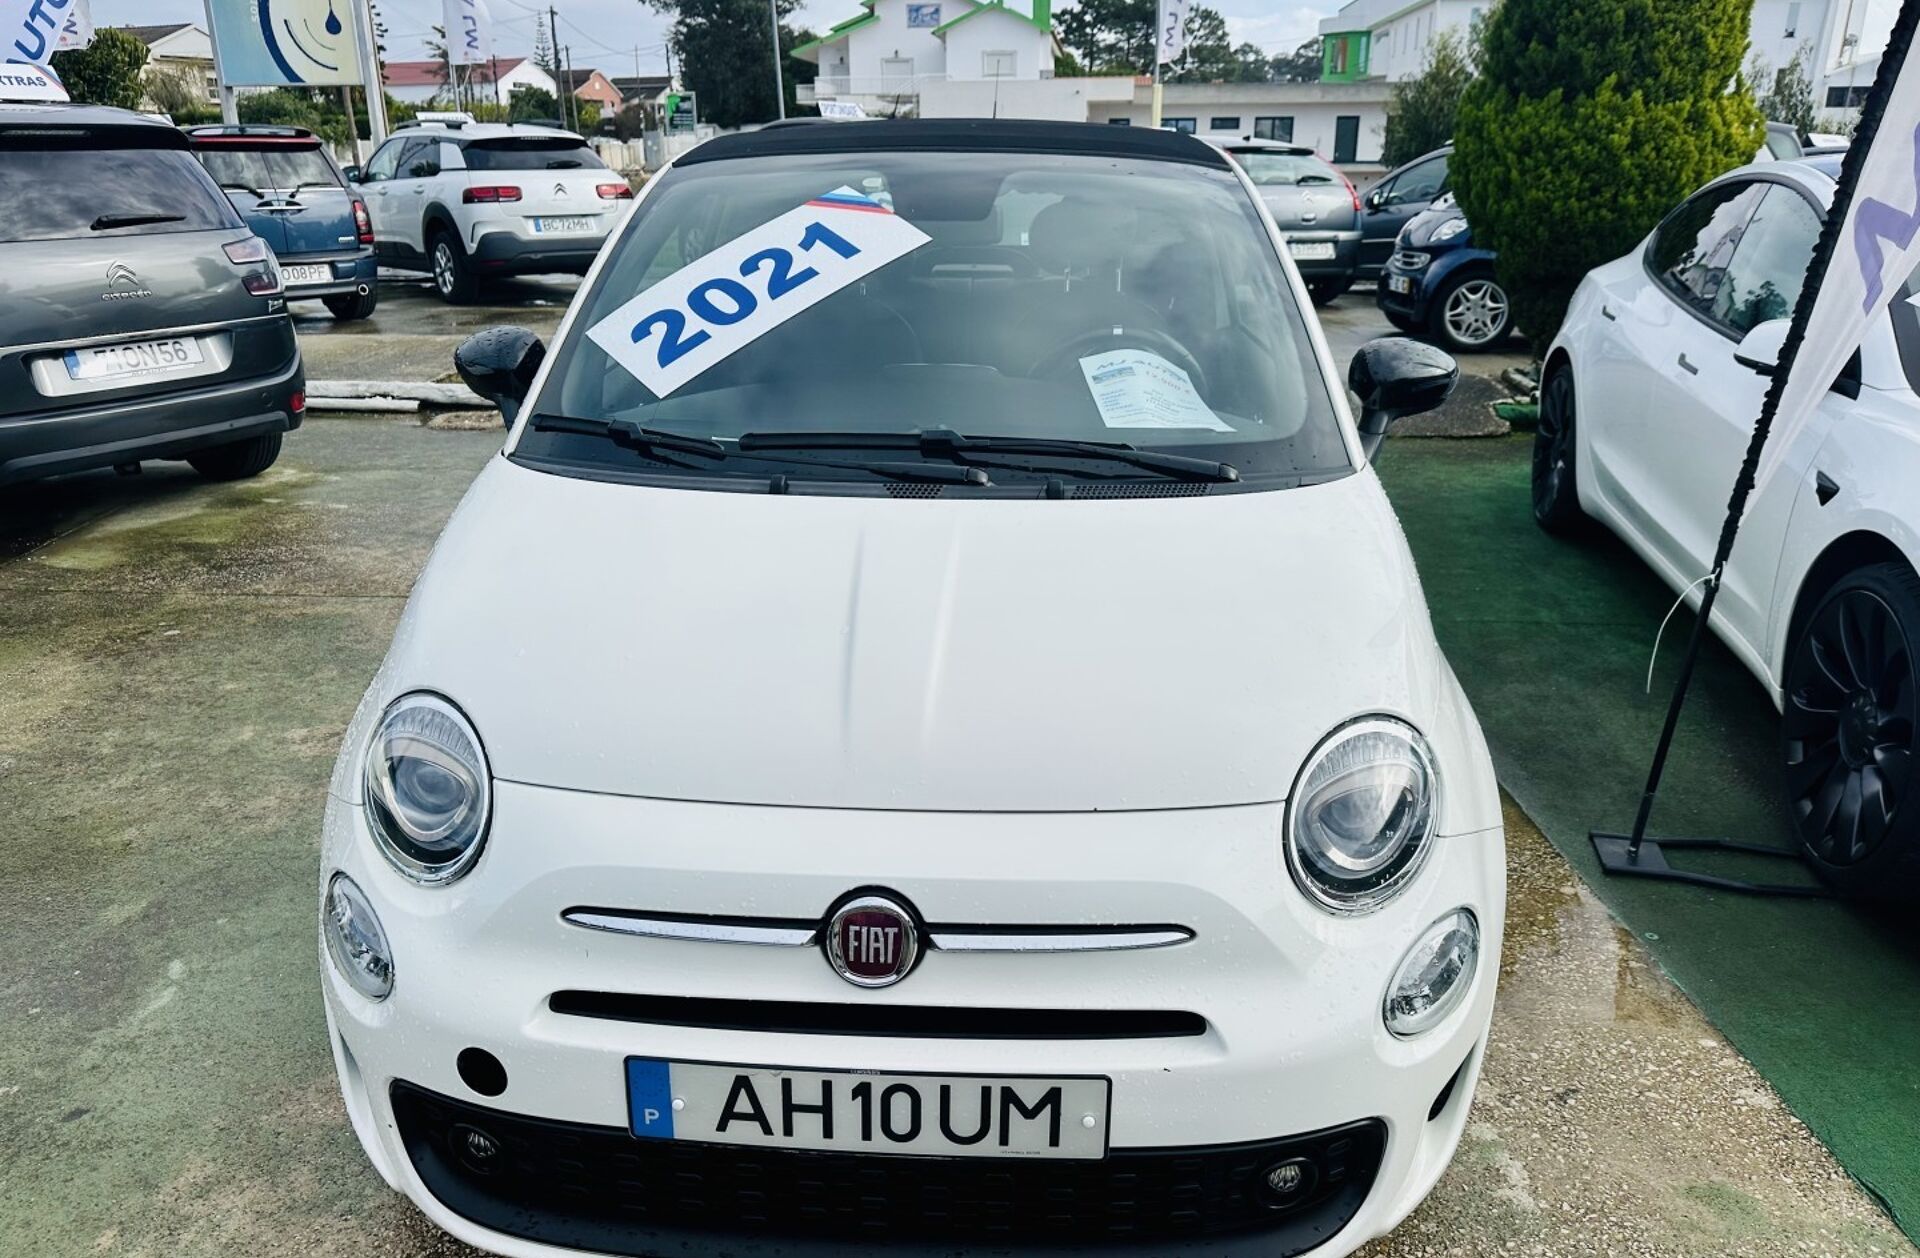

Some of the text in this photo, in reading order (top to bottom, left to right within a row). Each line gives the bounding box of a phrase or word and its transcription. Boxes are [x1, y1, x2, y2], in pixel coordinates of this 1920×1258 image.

[631, 221, 862, 369] 2021
[848, 923, 899, 964] FIAT
[644, 1108, 660, 1125] P
